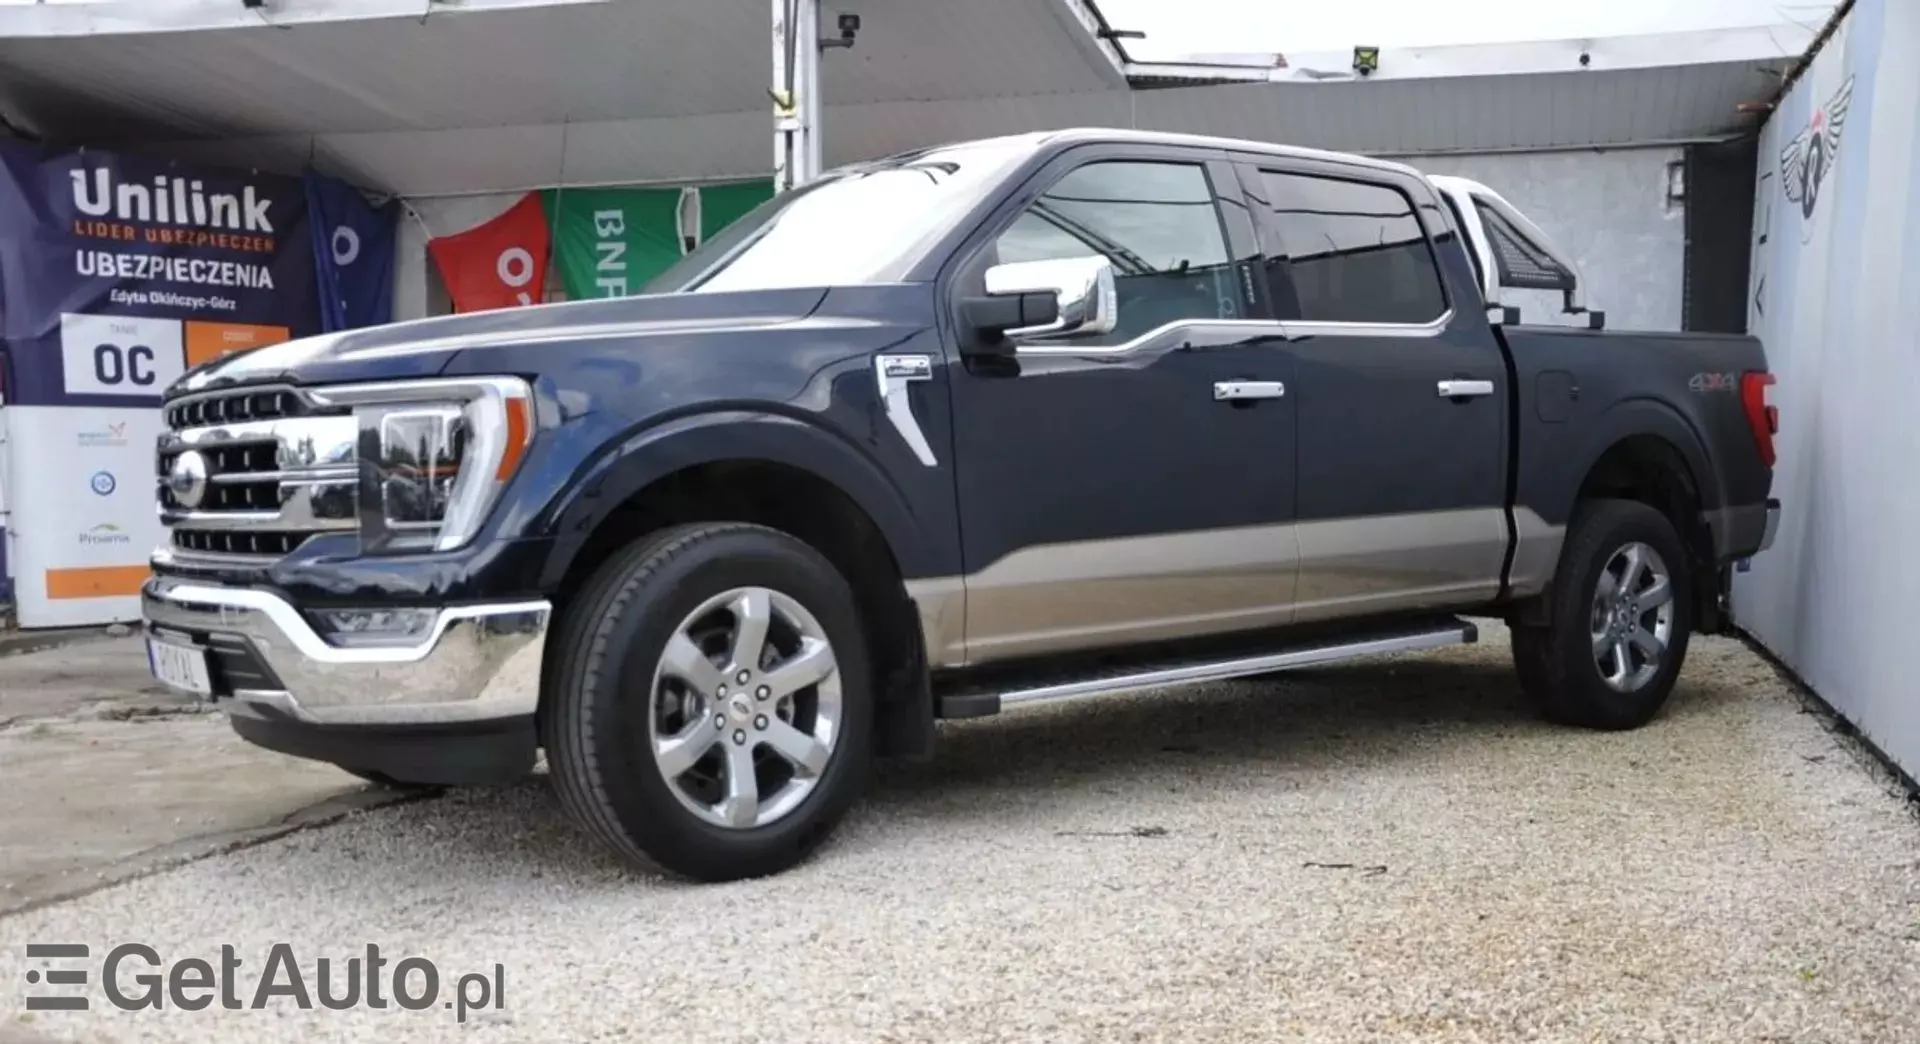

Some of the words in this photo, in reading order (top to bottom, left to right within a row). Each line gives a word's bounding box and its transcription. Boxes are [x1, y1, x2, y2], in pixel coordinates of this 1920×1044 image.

[69, 167, 274, 233] Unilink
[74, 220, 135, 241] LIDER
[76, 249, 274, 290] UBEZPIECZENIA
[110, 288, 148, 306] Edyta
[94, 343, 156, 386] OC
